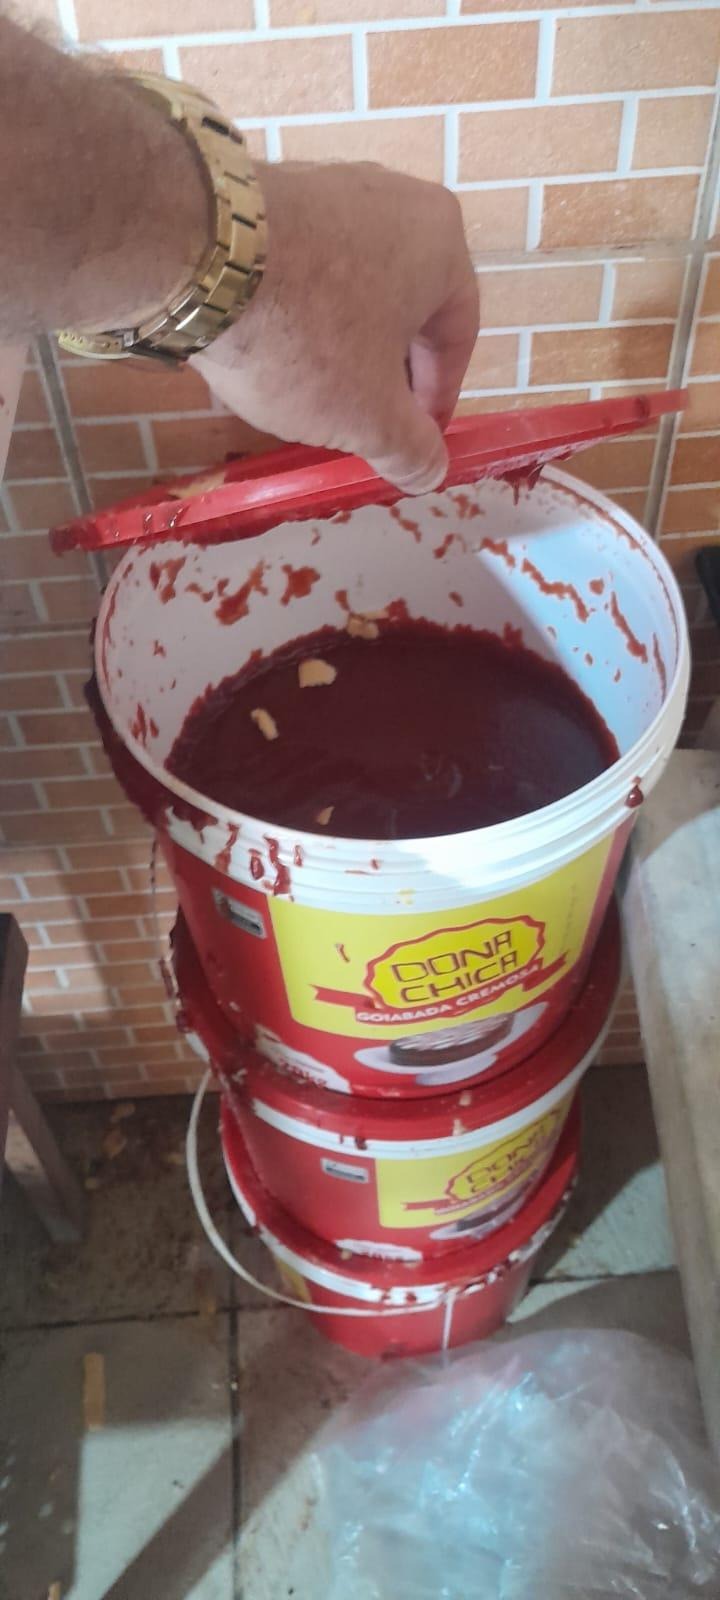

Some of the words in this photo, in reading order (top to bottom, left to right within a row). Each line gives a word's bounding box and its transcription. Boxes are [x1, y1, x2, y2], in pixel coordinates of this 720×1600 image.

[391, 931, 512, 983] DONA
[402, 951, 518, 1003] CHICA
[356, 1004, 452, 1022] GOIABADA
[456, 963, 539, 1006] CREMOSA
